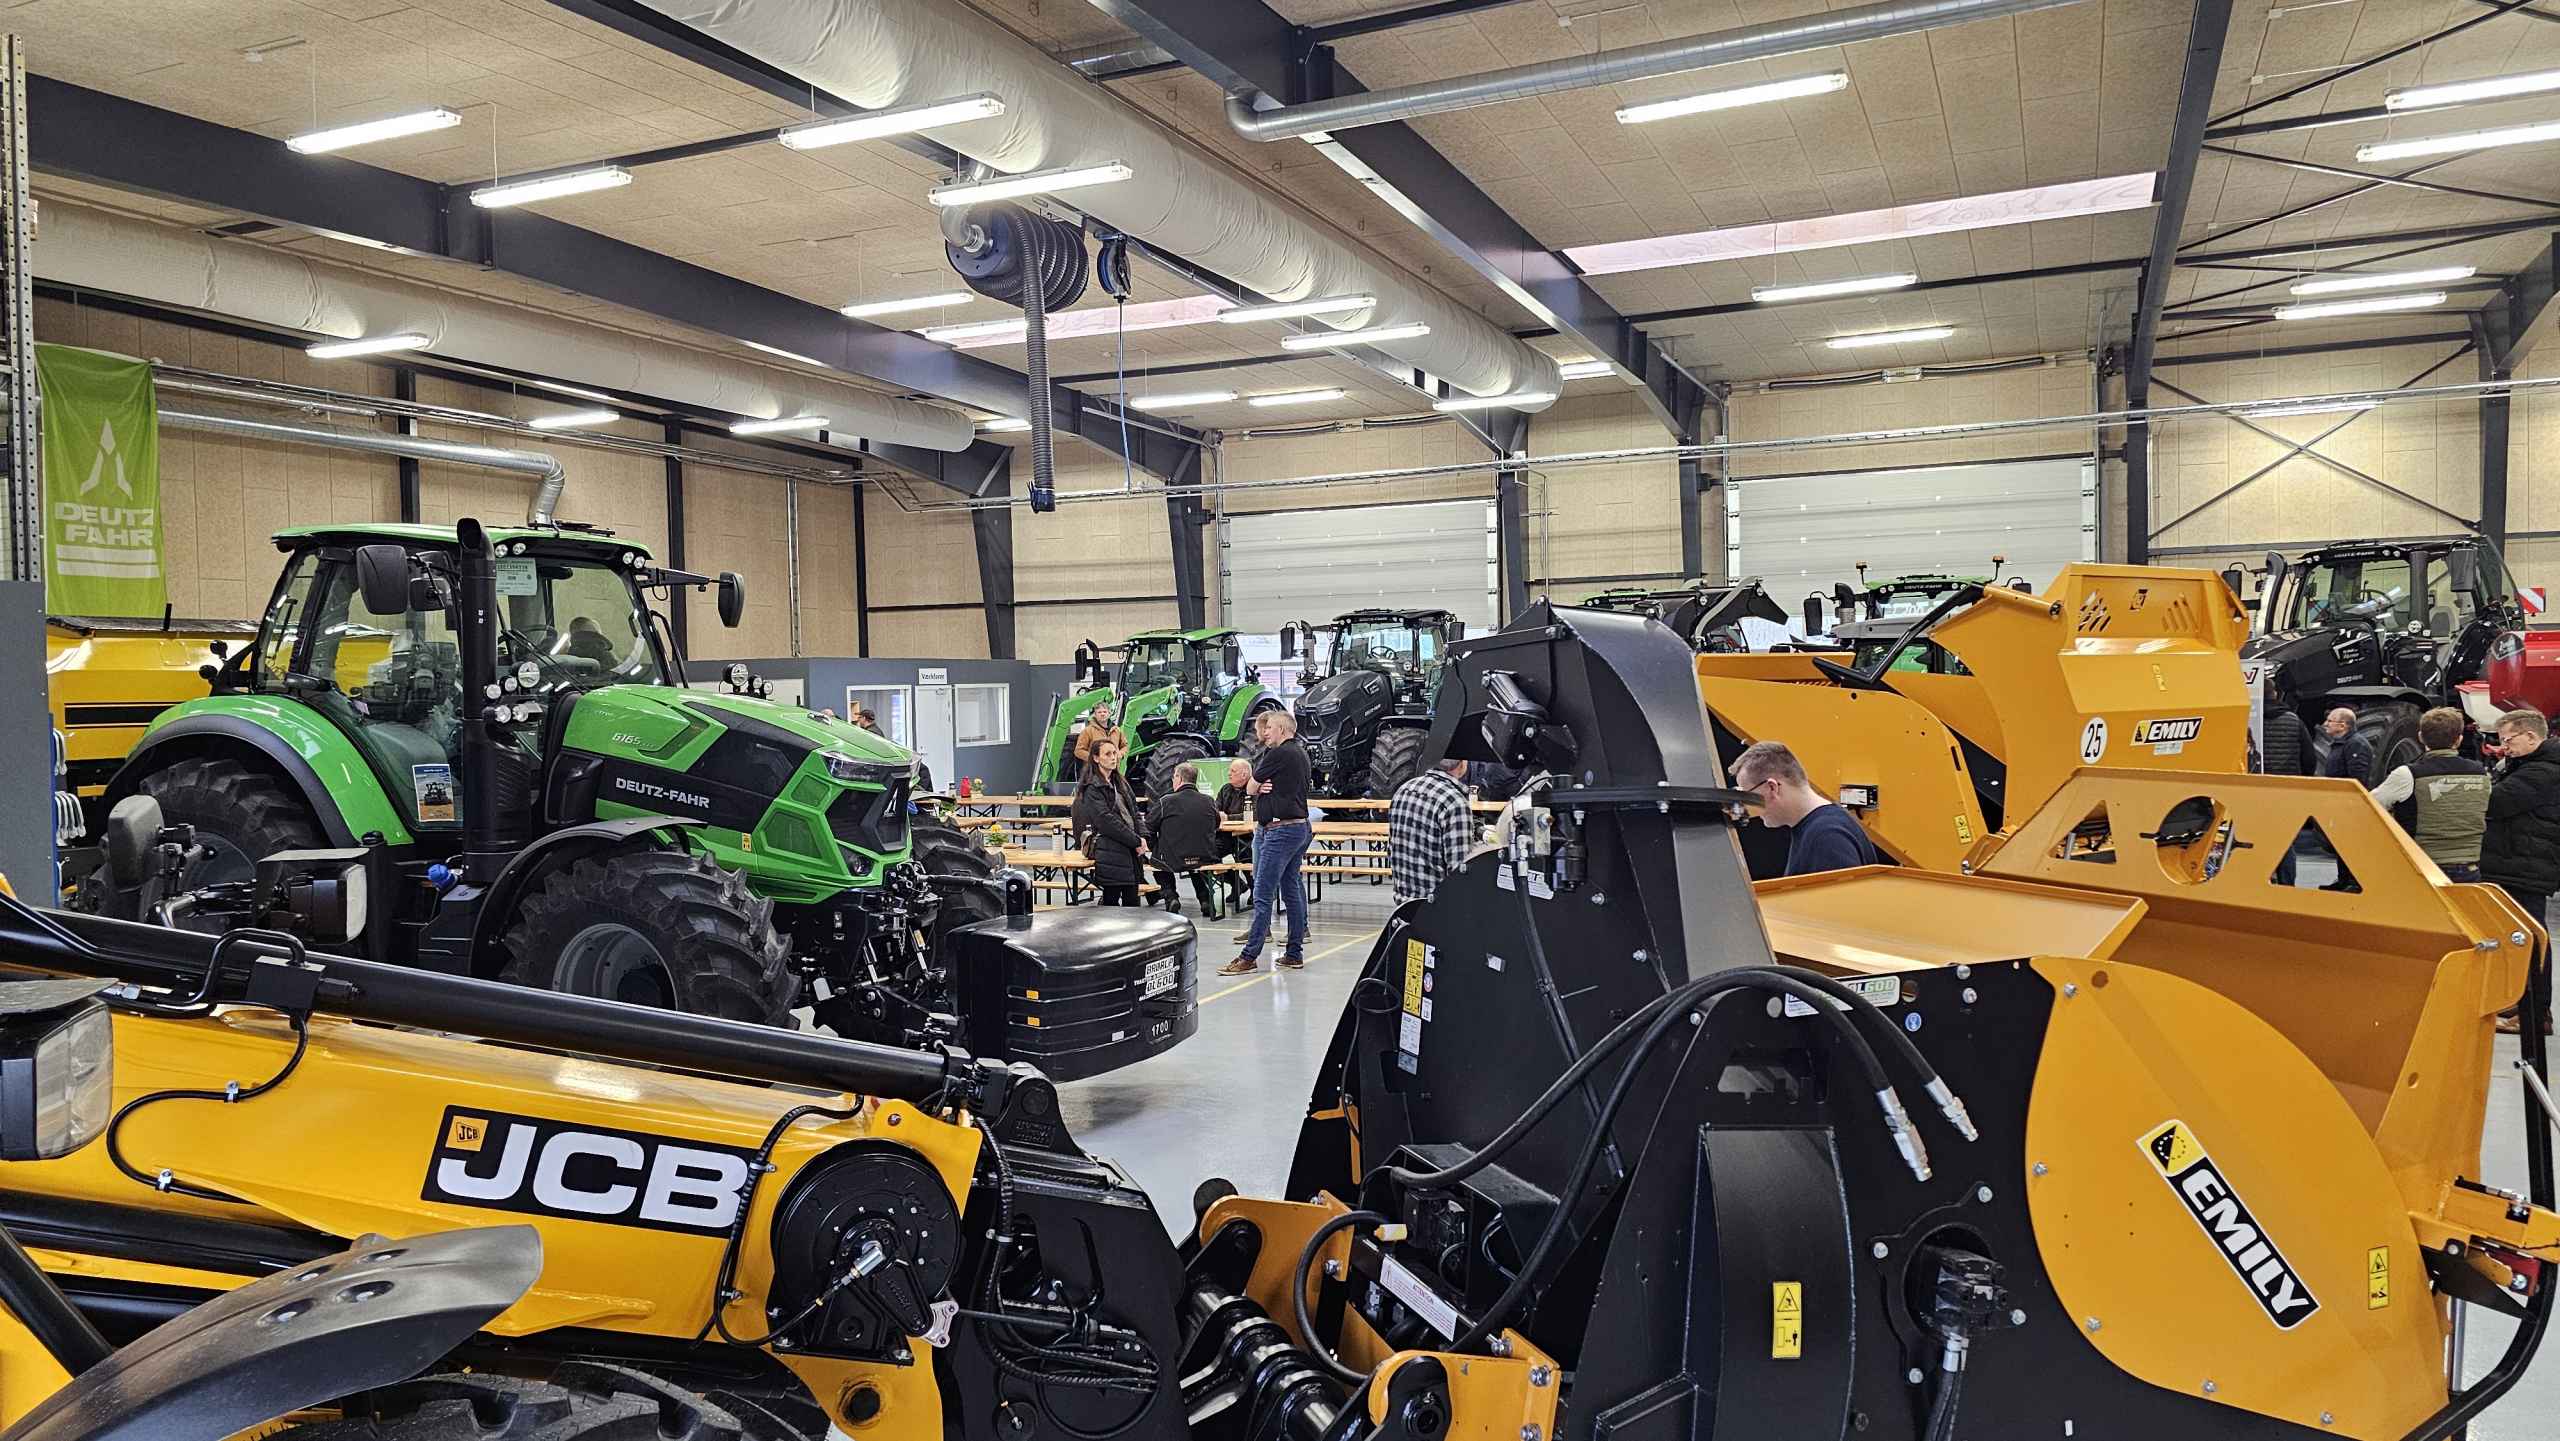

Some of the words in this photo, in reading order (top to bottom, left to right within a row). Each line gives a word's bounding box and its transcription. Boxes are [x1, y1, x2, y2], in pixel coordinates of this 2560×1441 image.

[55, 502, 154, 528] DEUTZ
[65, 524, 153, 546] FAHR
[2084, 723, 2104, 757] 25
[2147, 720, 2201, 741] EMILY
[615, 777, 710, 809] DEUTZ-FAHR
[1151, 1020, 1169, 1037] 1700
[458, 1125, 479, 1141] JCB
[437, 1123, 748, 1228] JCB
[2182, 1168, 2310, 1314] EMILY
